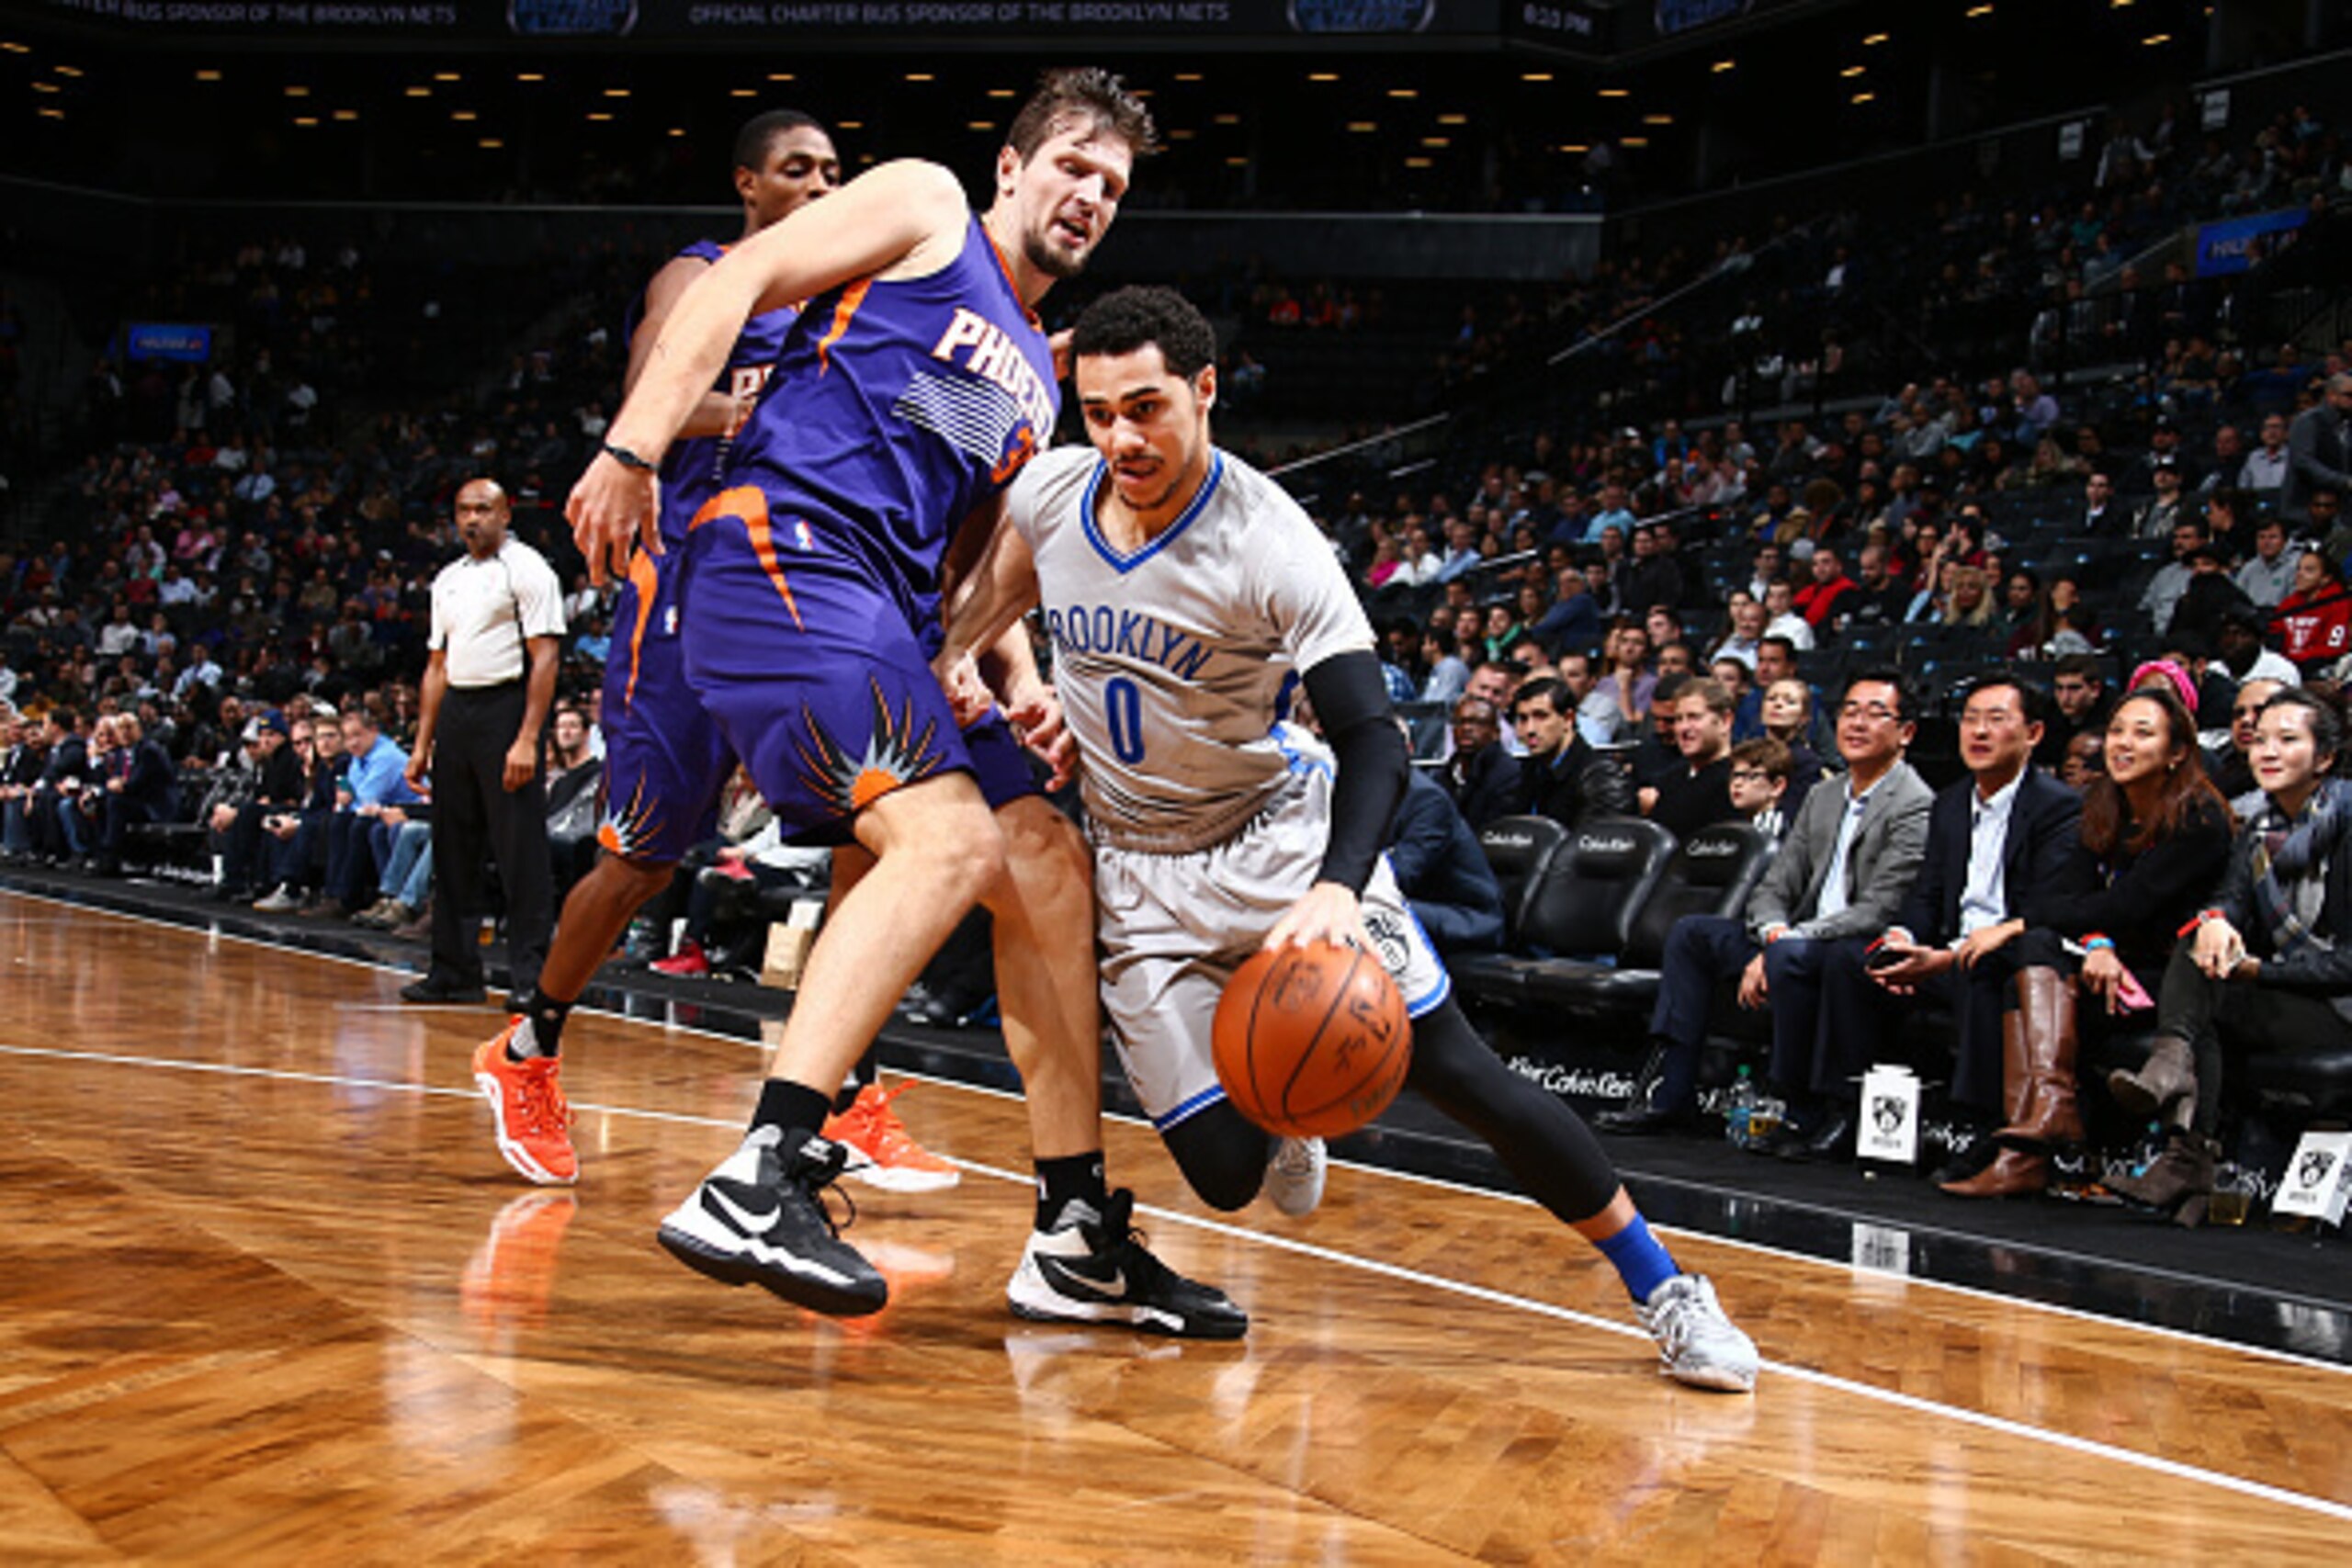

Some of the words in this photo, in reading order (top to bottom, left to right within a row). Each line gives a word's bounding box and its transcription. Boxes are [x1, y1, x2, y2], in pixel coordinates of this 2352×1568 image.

[164, 3, 246, 22] SPONSOR
[248, 4, 271, 23] OF
[275, 5, 308, 24] THE
[311, 5, 406, 25] BROOKLYN
[409, 6, 458, 25] NETS
[688, 4, 766, 25] OFFICIAL
[769, 4, 859, 25] CHARTER
[862, 4, 901, 24] BUS
[904, 4, 993, 23] SPONSOR
[996, 3, 1021, 22] OF
[1028, 3, 1064, 22] THE
[1068, 3, 1172, 22] BROOKLYN
[1175, 3, 1230, 22] NETS
[1047, 604, 1213, 682] ROOKLYN
[1105, 676, 1145, 764] 0
[1544, 1065, 1597, 1095] Calvin
[1597, 1071, 1636, 1099] Klein
